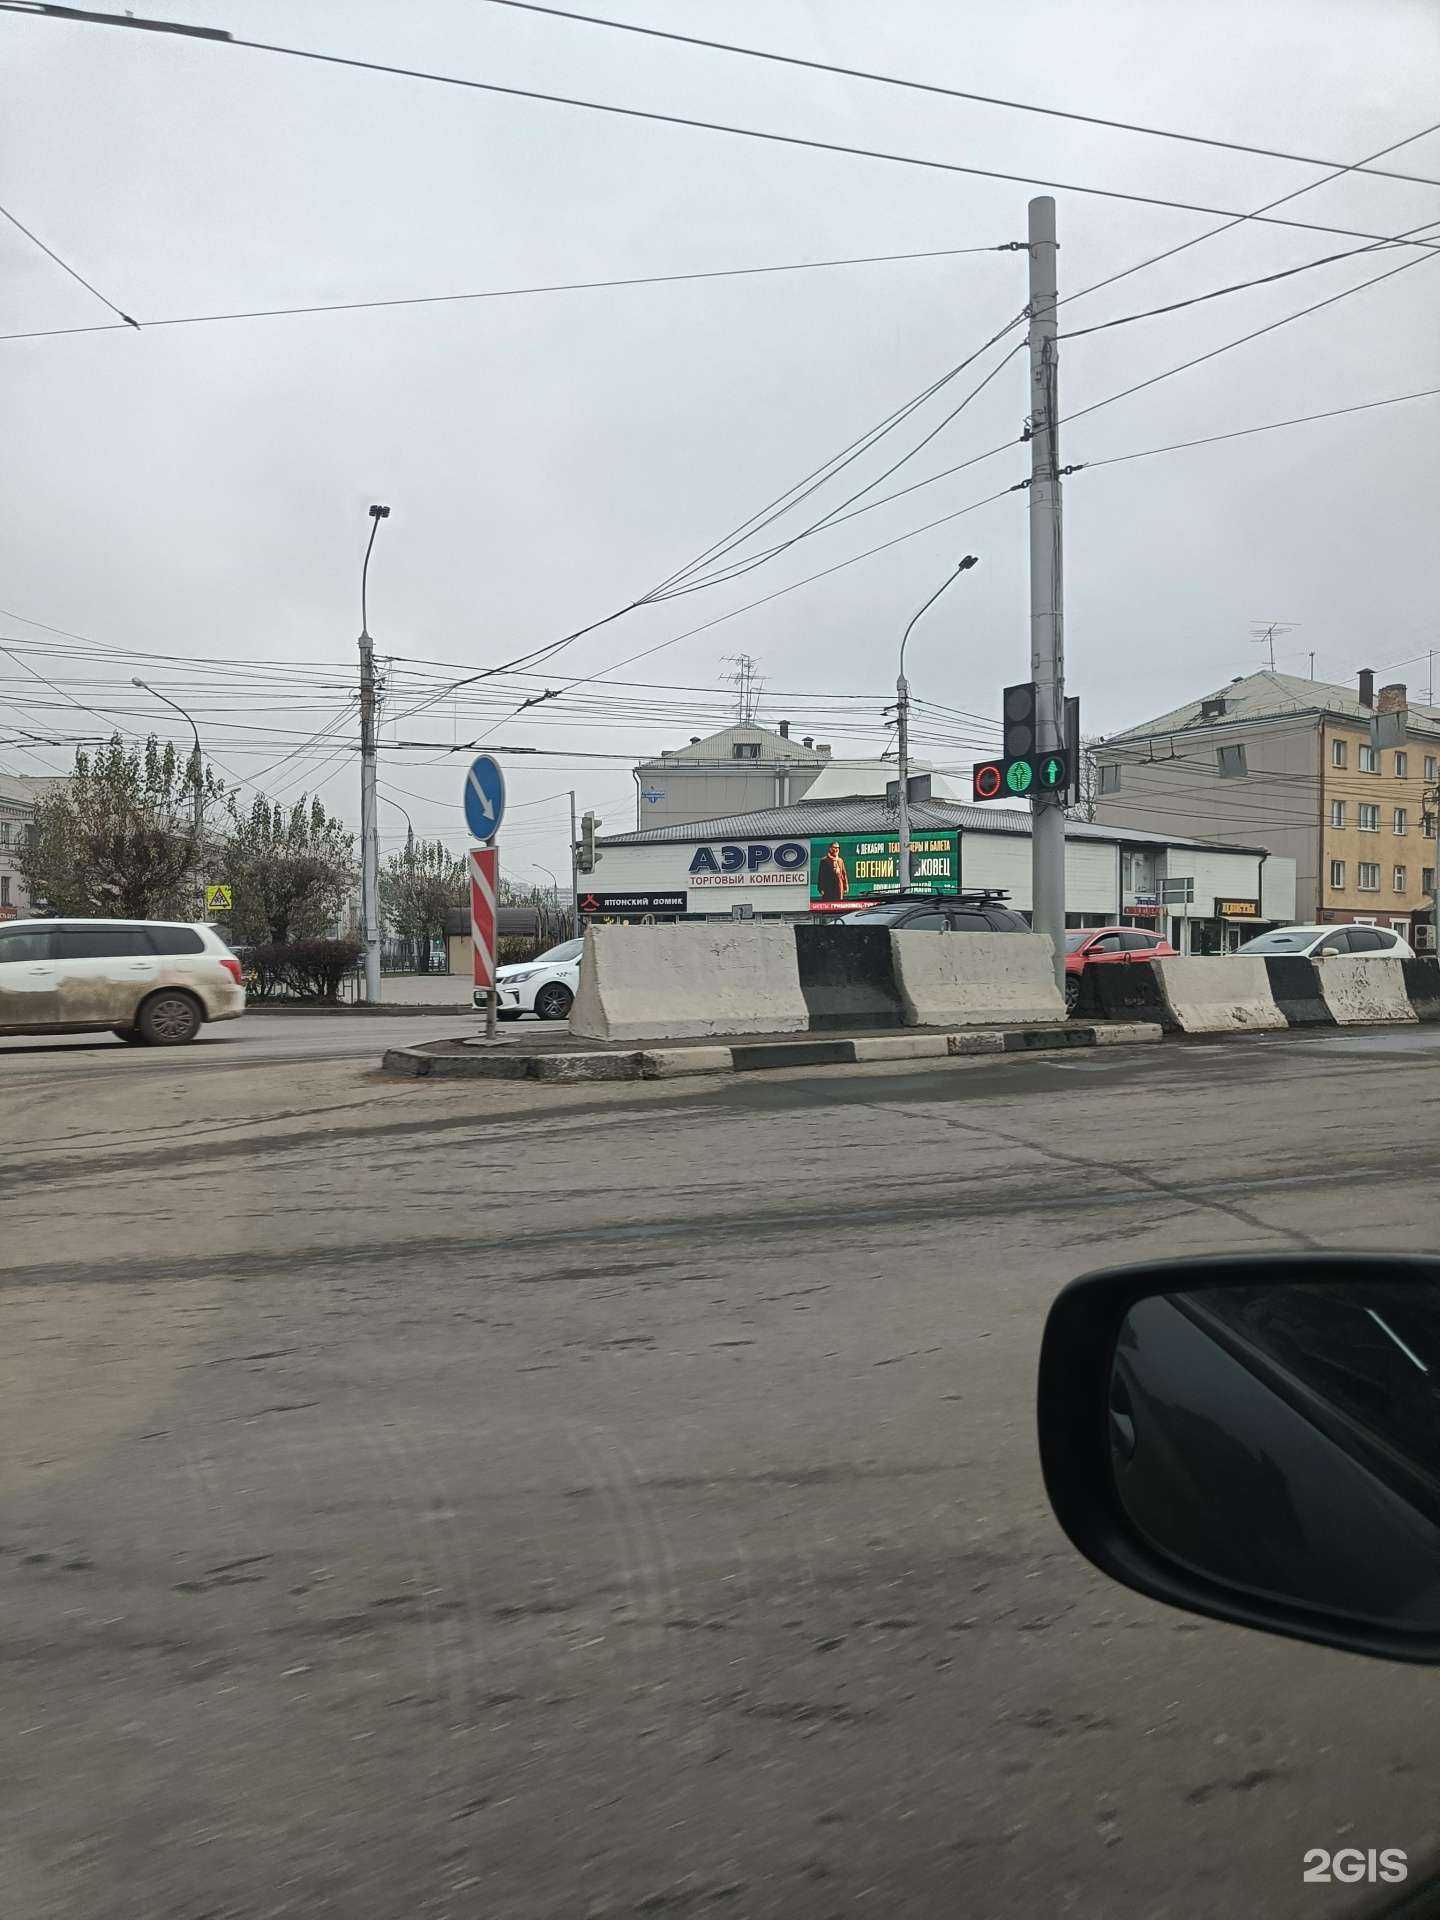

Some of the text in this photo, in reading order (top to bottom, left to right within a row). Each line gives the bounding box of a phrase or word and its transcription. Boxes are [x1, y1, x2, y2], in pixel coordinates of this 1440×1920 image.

[861, 843, 884, 855] ДЕКАБРЯ
[930, 840, 950, 852] БАЛЕТА
[688, 843, 808, 873] АЭРО
[856, 857, 893, 878] ЕВГЕНИЙ
[690, 873, 805, 886] ТОРГОВЫЙ КОМПЛЕКС
